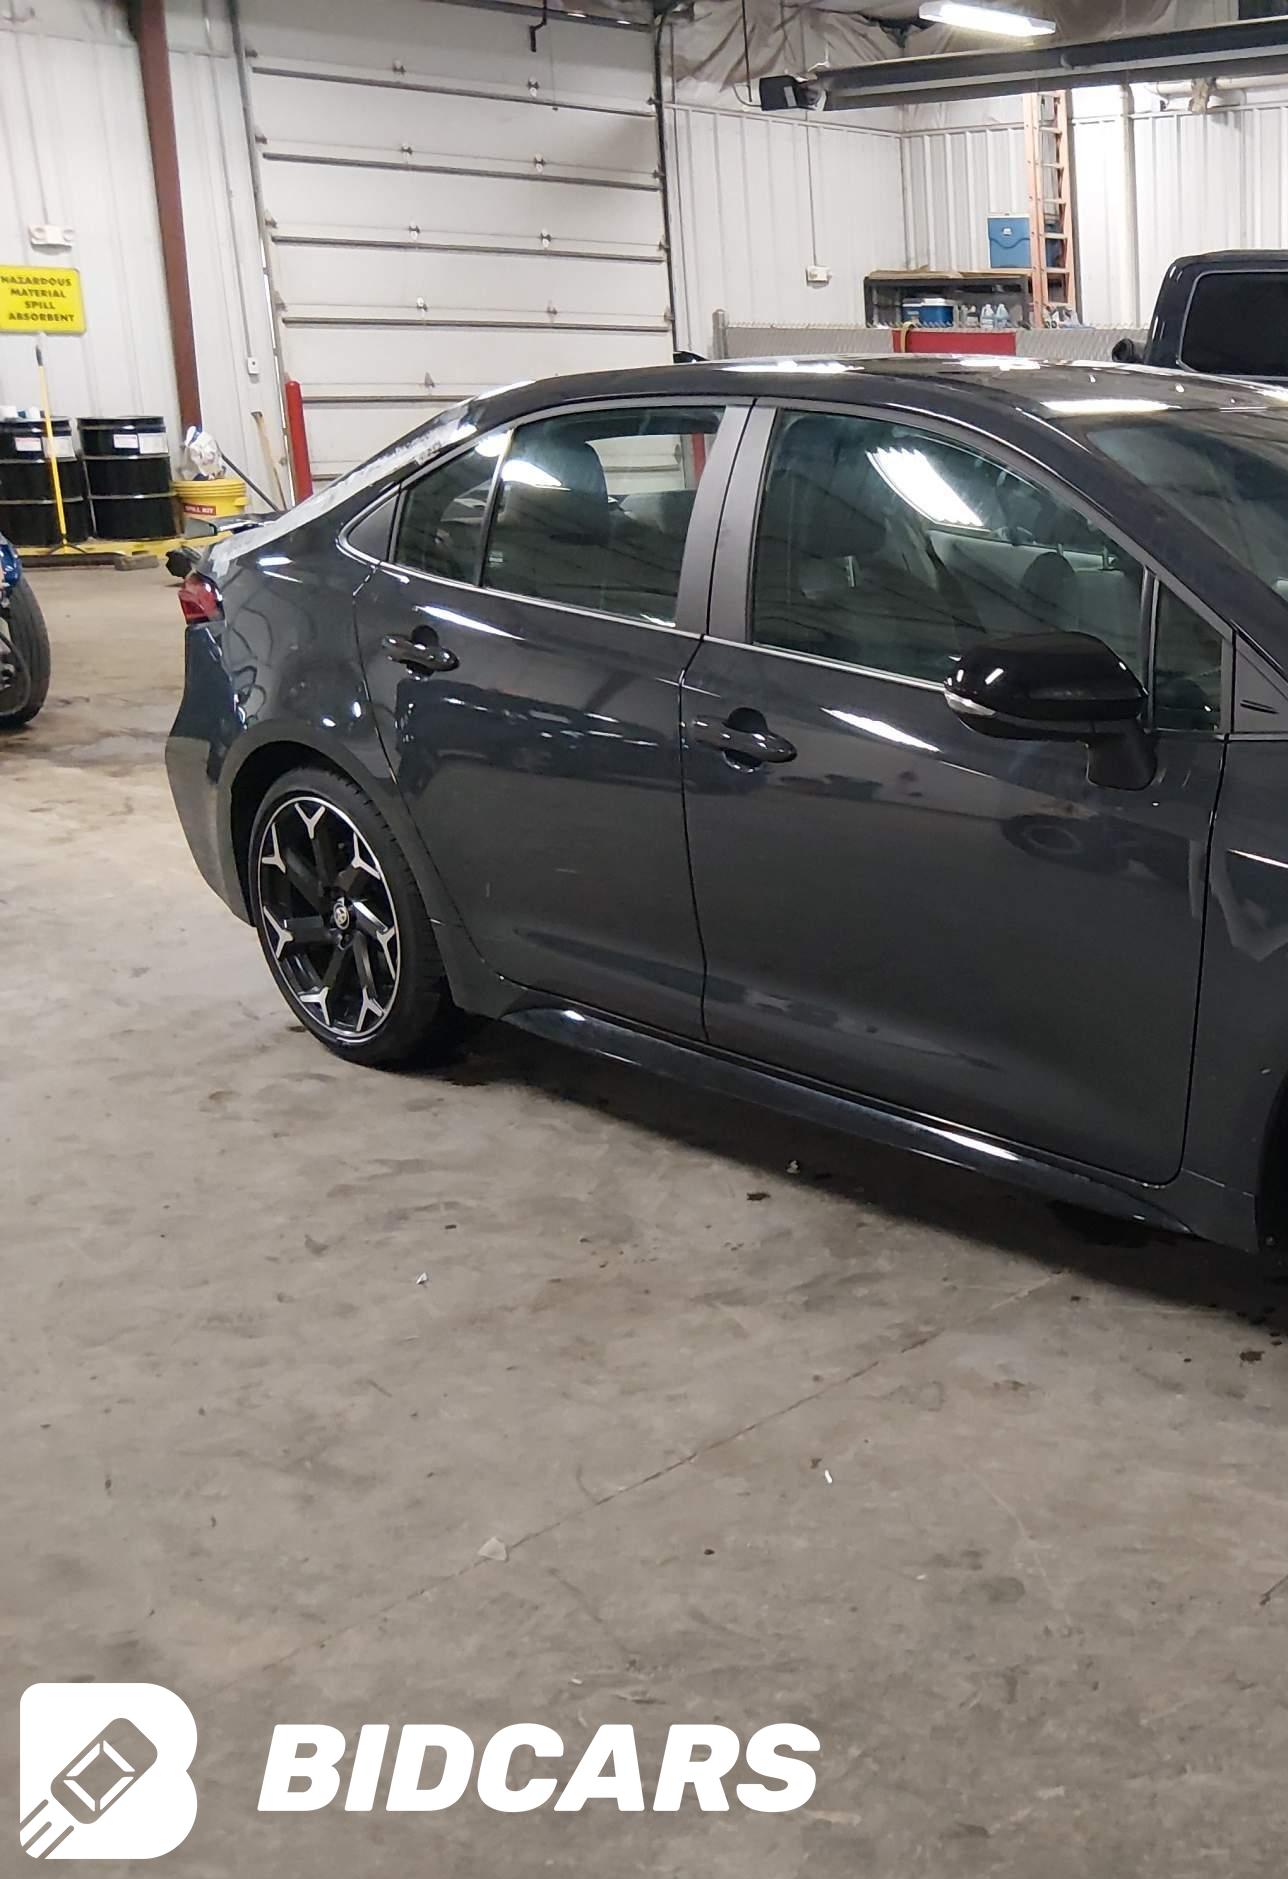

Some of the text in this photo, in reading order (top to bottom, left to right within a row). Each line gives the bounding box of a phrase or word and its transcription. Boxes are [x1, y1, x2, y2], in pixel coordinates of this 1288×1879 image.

[0, 276, 72, 286] HAZARDOUS
[10, 288, 67, 298] MATERIAL
[25, 301, 56, 310] SPILL
[9, 312, 74, 322] ABSORBENT
